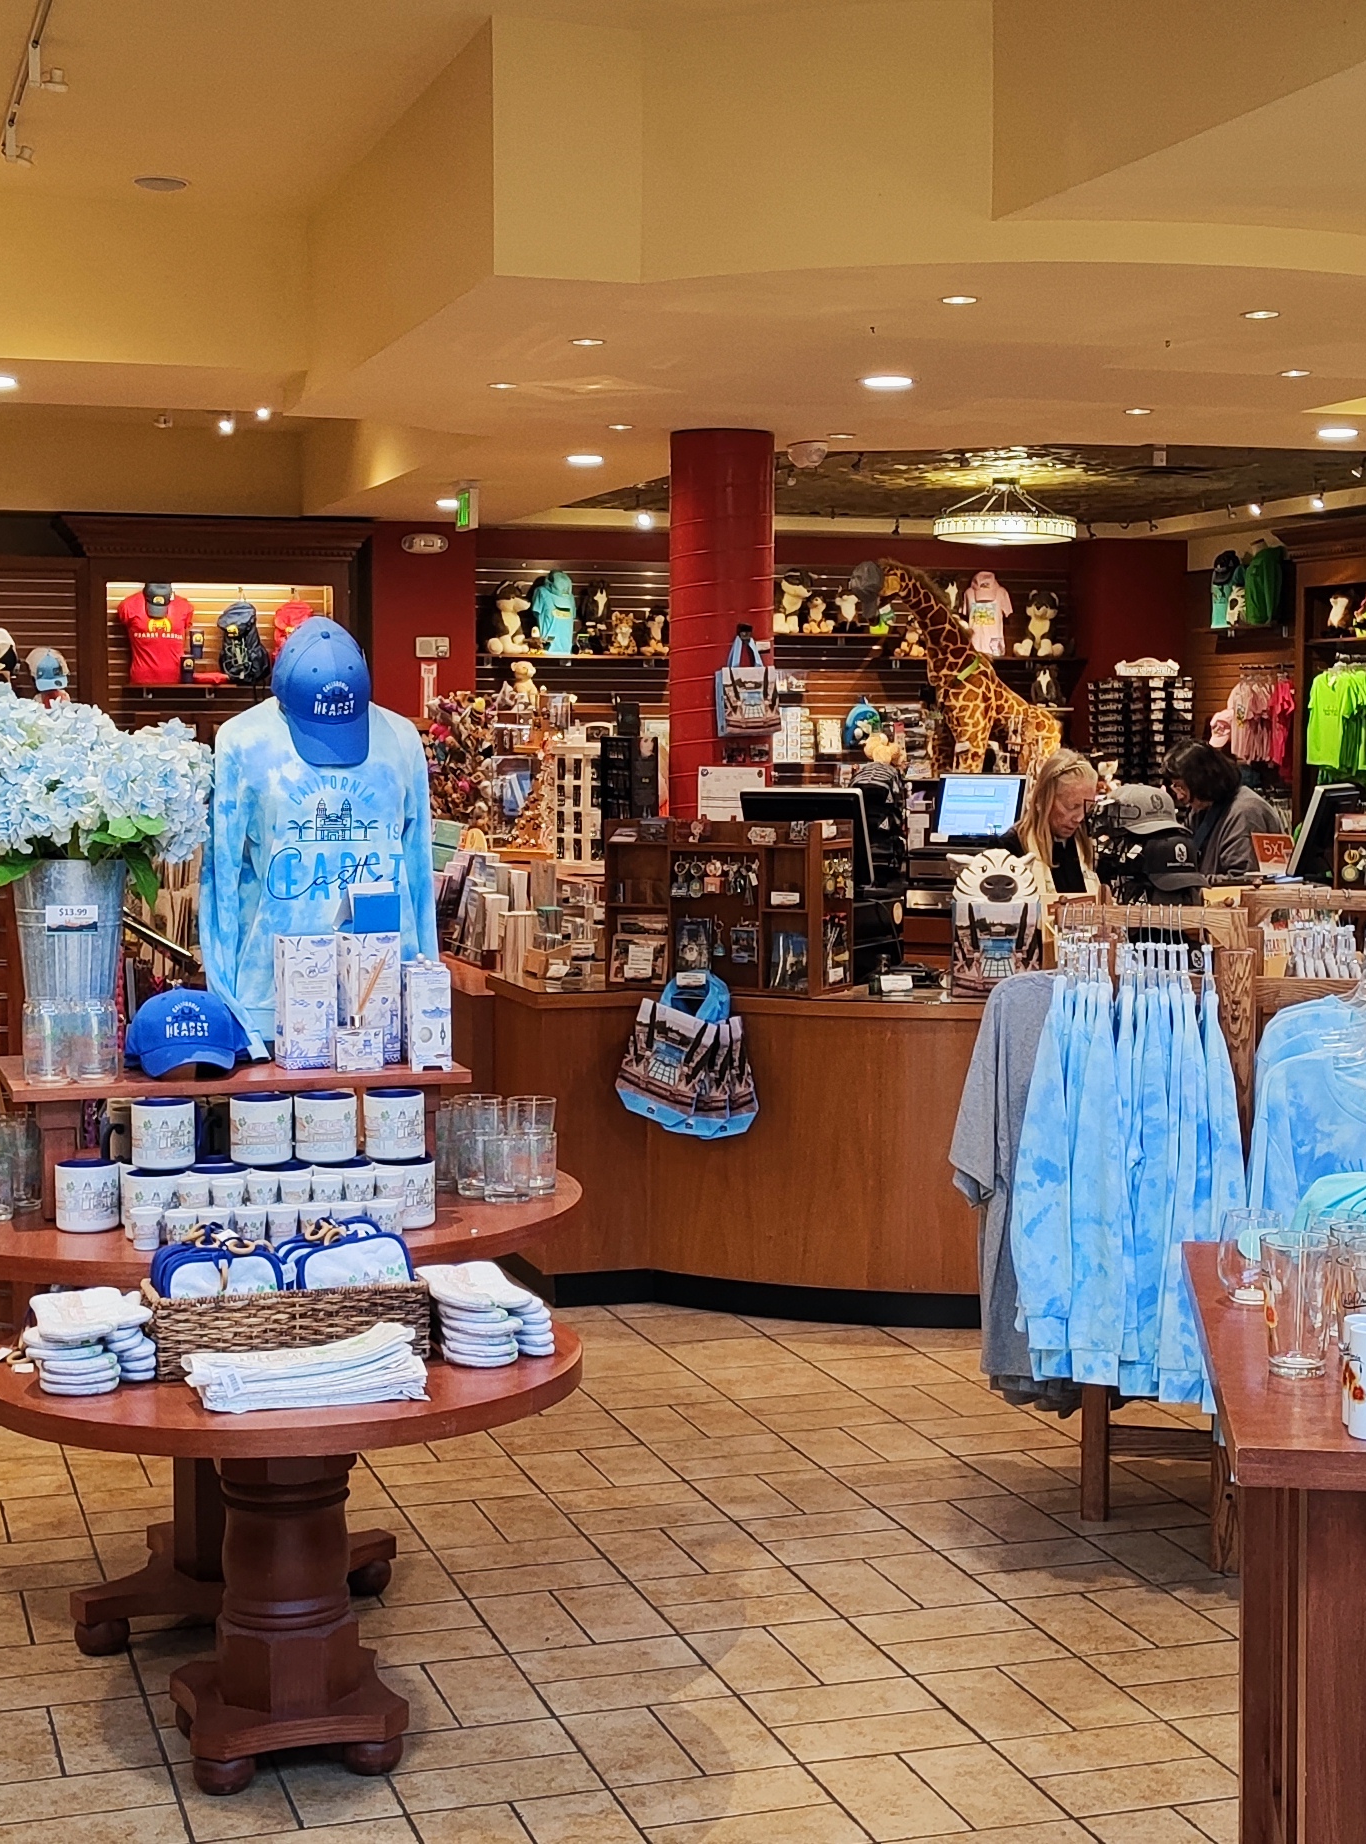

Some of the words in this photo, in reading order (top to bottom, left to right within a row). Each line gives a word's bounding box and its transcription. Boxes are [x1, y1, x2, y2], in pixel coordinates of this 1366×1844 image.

[313, 699, 355, 716] HEARST
[289, 775, 375, 806] CALIFORNIA
[386, 823, 400, 841] 19
[1263, 840, 1286, 856] 5x7
[267, 847, 384, 900] Castl
[58, 907, 88, 917] $13.99
[165, 1022, 209, 1039] HEARST
